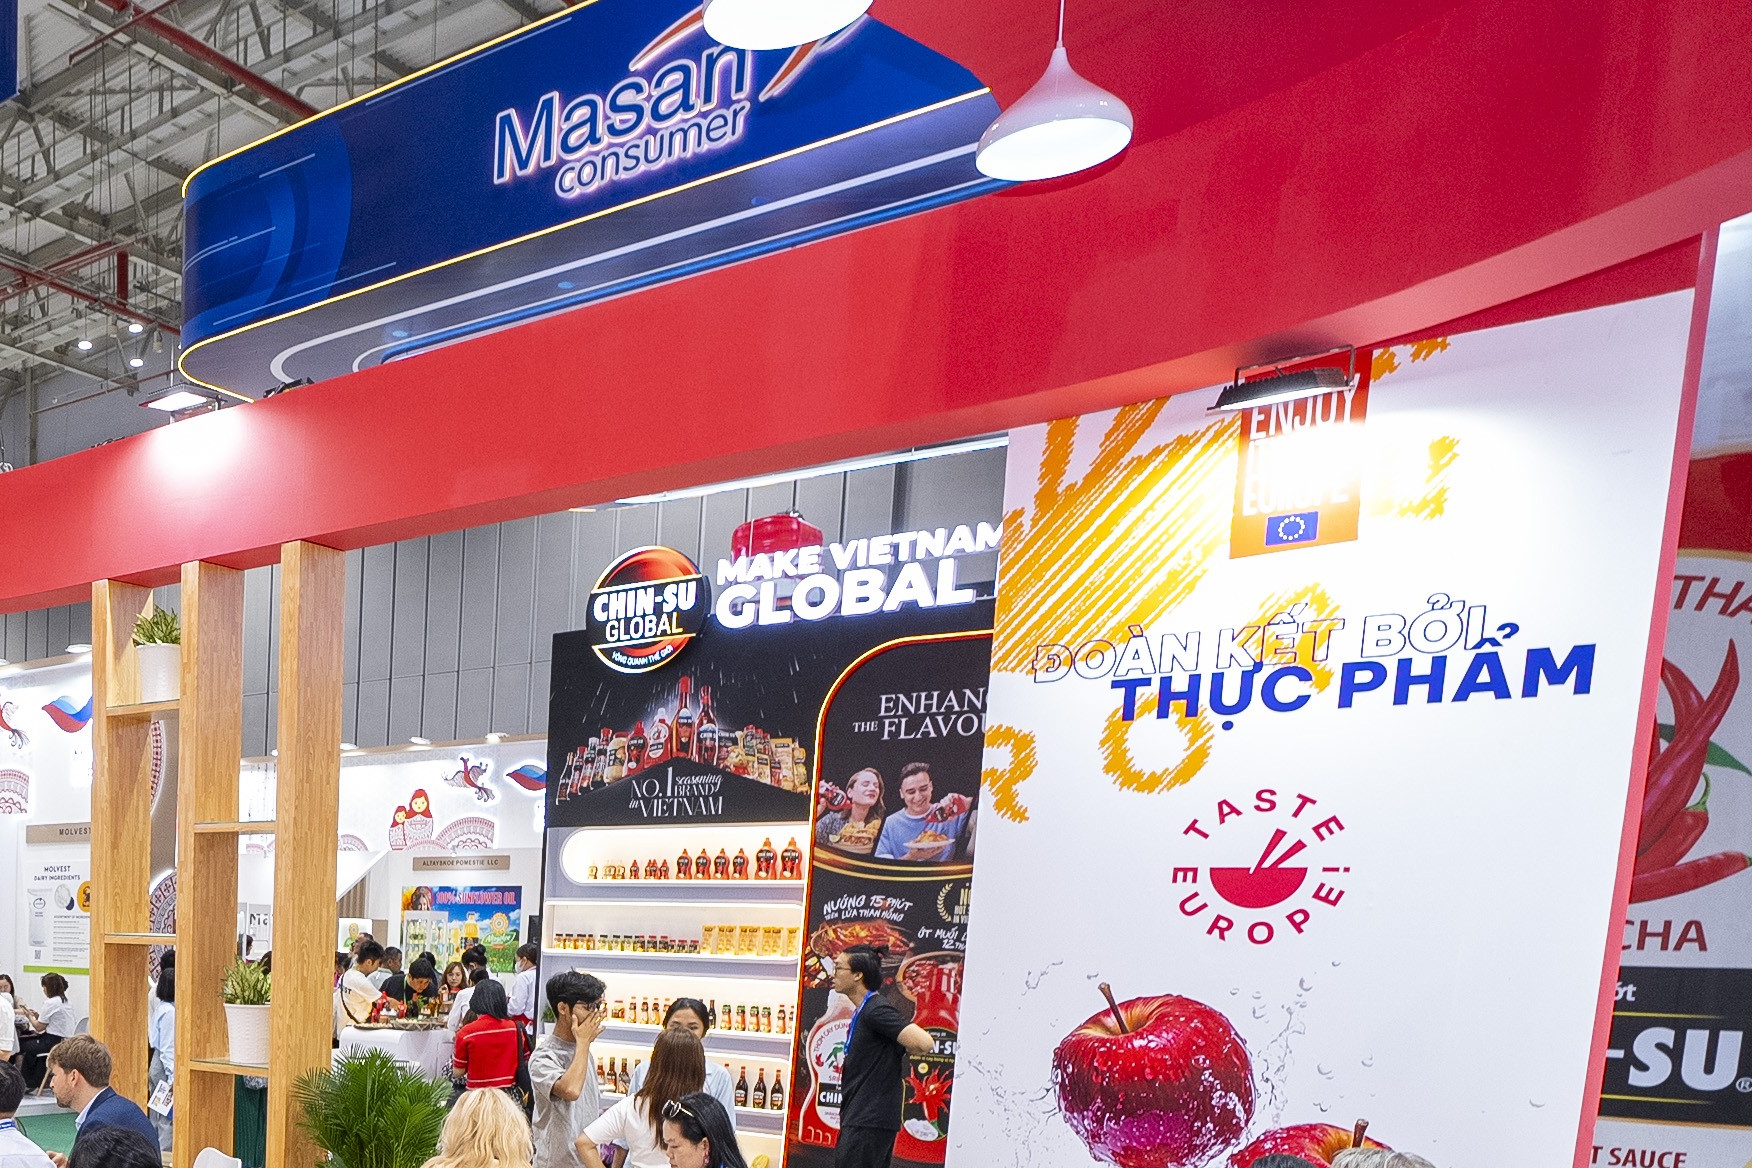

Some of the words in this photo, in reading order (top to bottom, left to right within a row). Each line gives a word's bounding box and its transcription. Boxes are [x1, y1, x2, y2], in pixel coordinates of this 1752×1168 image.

[494, 48, 750, 183] Masan
[555, 100, 750, 199] consumer
[715, 544, 821, 586] MAKE
[826, 521, 1003, 573] VIETNAM
[593, 581, 697, 621] CHIN-SU
[714, 556, 975, 630] GLOBAL
[605, 611, 684, 642] GLOBAL
[1032, 625, 1201, 684] ĐOÀN
[1216, 603, 1345, 668] KẾT
[1360, 593, 1486, 658] BỞI
[1111, 661, 1313, 731] THỰC
[1337, 623, 1596, 709] PHẨM
[878, 687, 989, 717] ENHAN
[852, 721, 878, 733] THE
[674, 783, 713, 796] BRAND
[675, 773, 723, 791] seasoning
[637, 796, 723, 818] VIETNAM
[1182, 788, 1345, 842] TASTE
[43, 865, 72, 873] MOLVEST
[436, 892, 456, 906] 100%
[457, 891, 503, 905] SUNFLOWER
[503, 891, 516, 905] OIL
[859, 908, 880, 918] THAN
[870, 895, 886, 908] 15
[942, 939, 954, 949] 12
